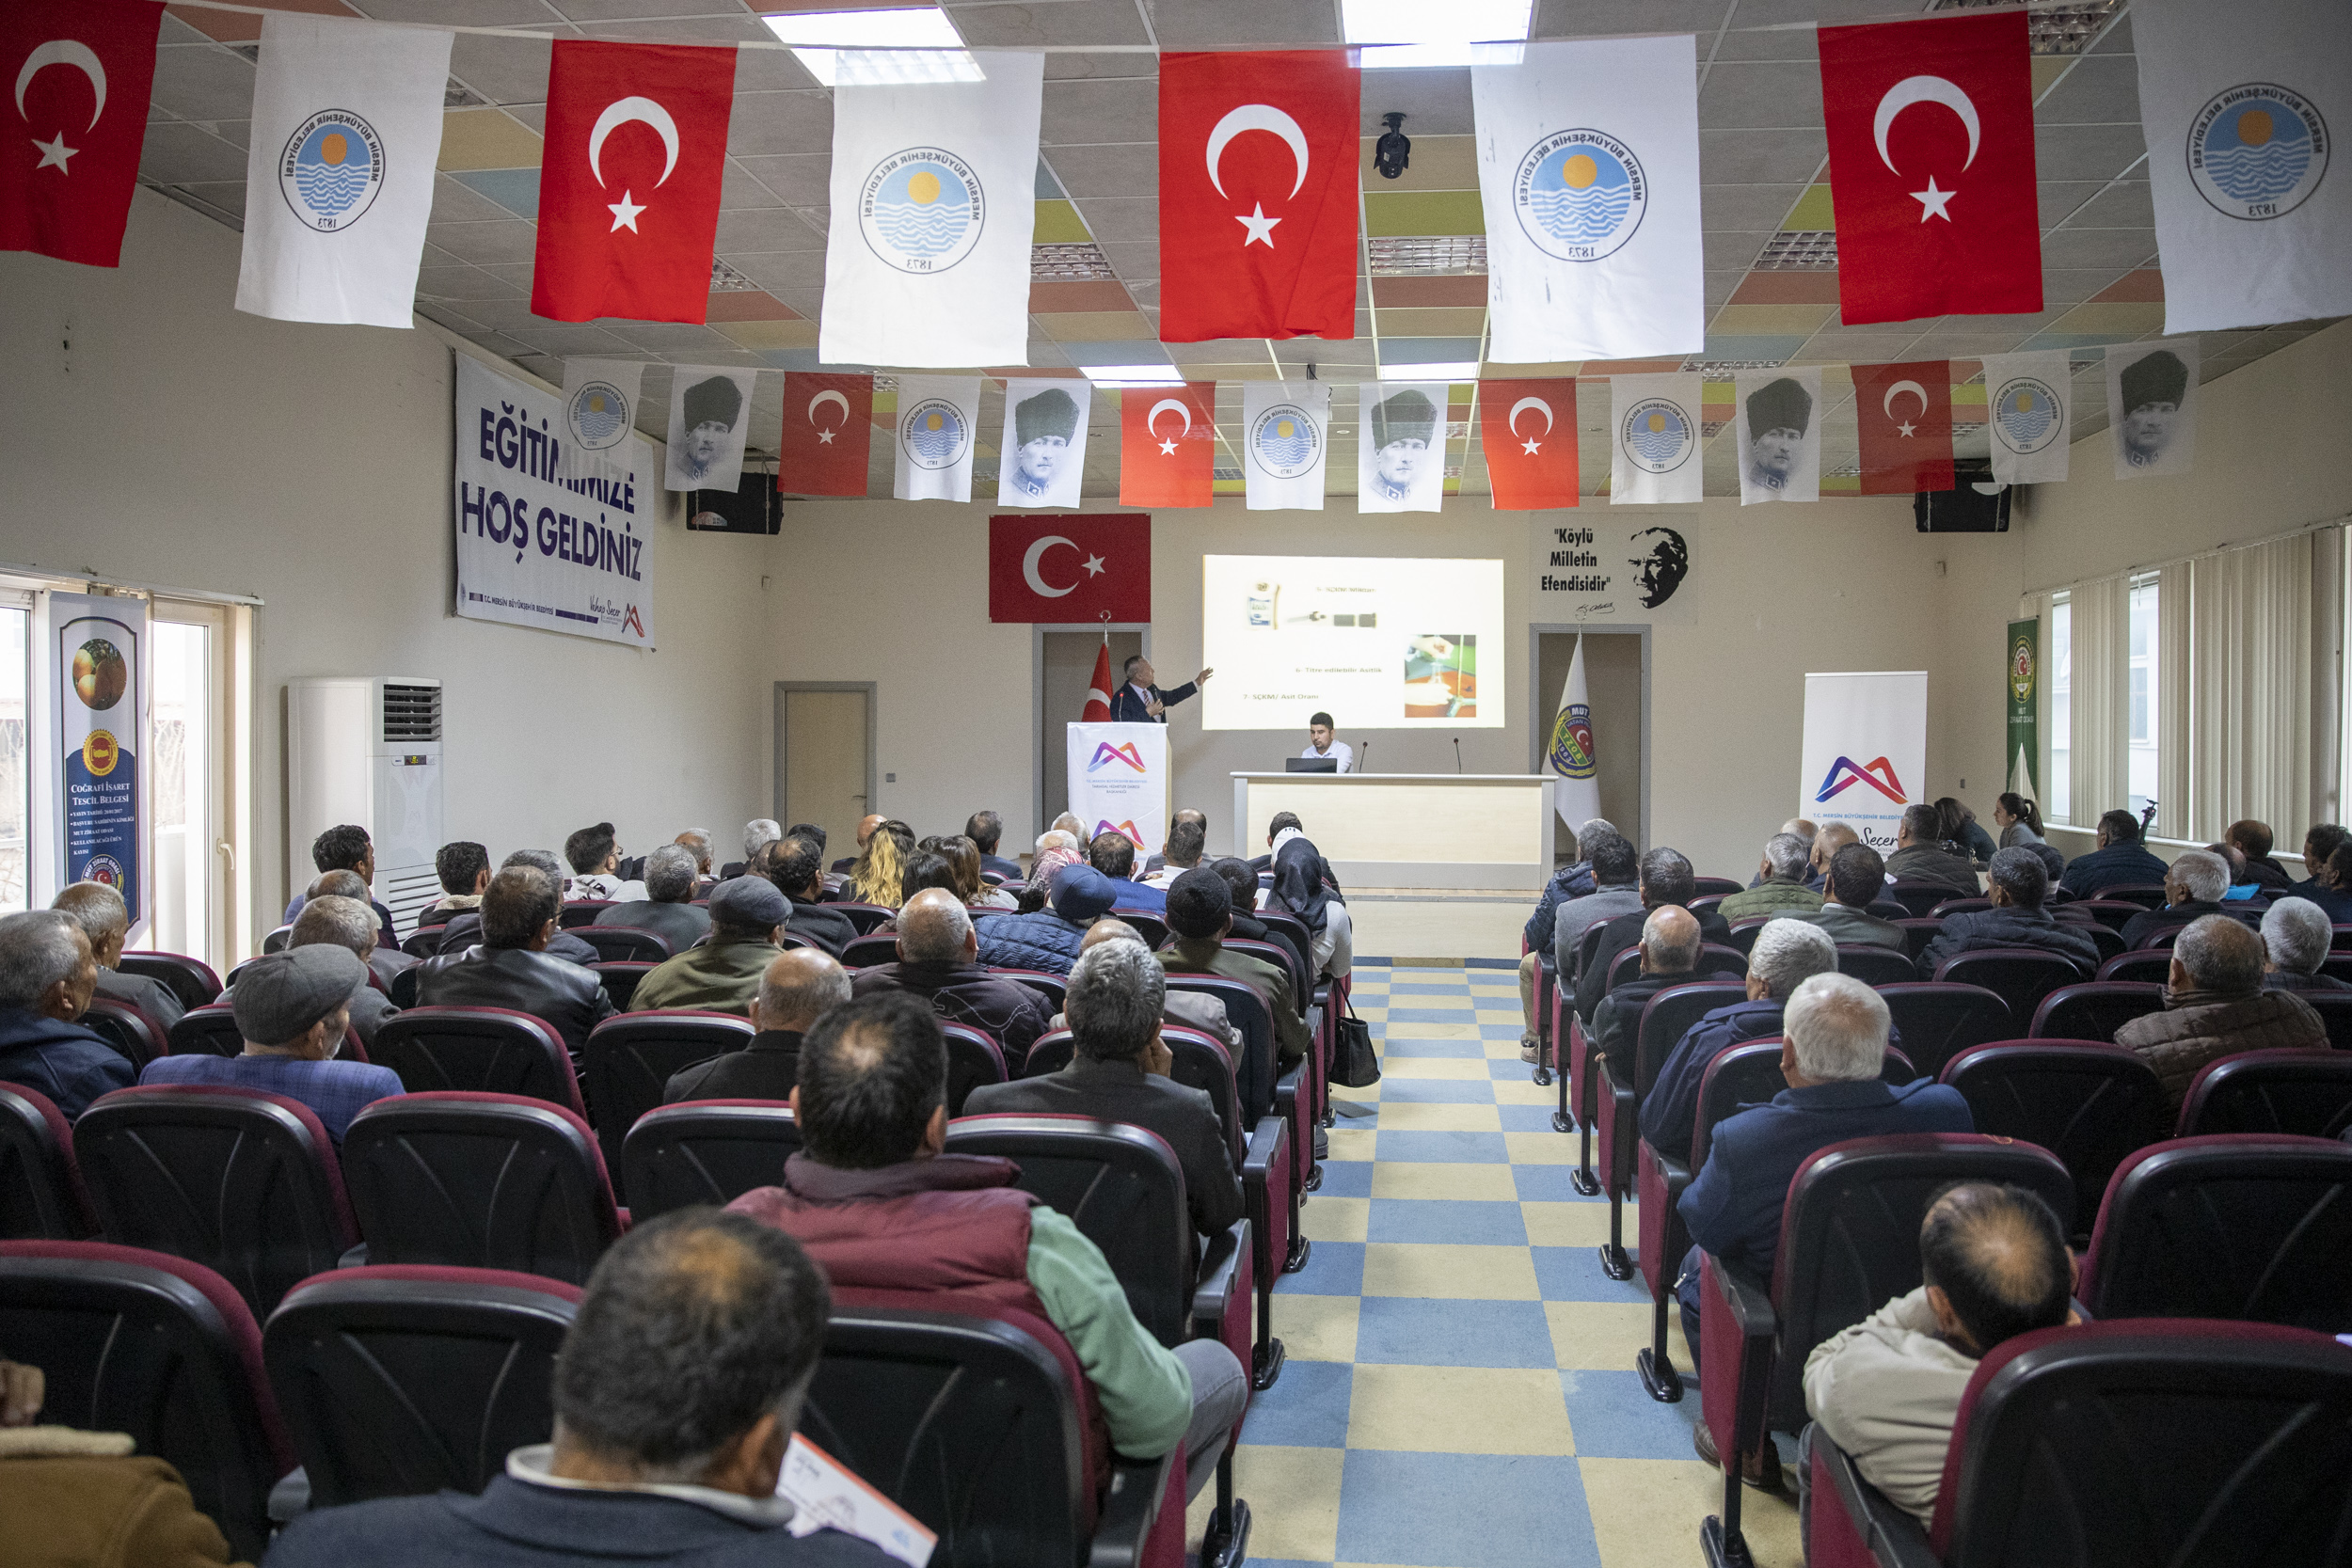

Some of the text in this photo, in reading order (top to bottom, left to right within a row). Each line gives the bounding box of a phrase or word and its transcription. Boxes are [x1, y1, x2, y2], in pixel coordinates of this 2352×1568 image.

[461, 481, 644, 582] HOŞ GELDİNİZ
[1554, 528, 1594, 547] "Köylü
[1549, 551, 1597, 567] Milletin
[1541, 576, 1611, 592] Efendisidir"
[1571, 707, 1589, 717] MUT
[1563, 733, 1582, 760] TZOB
[1860, 827, 1899, 847] Seçer
